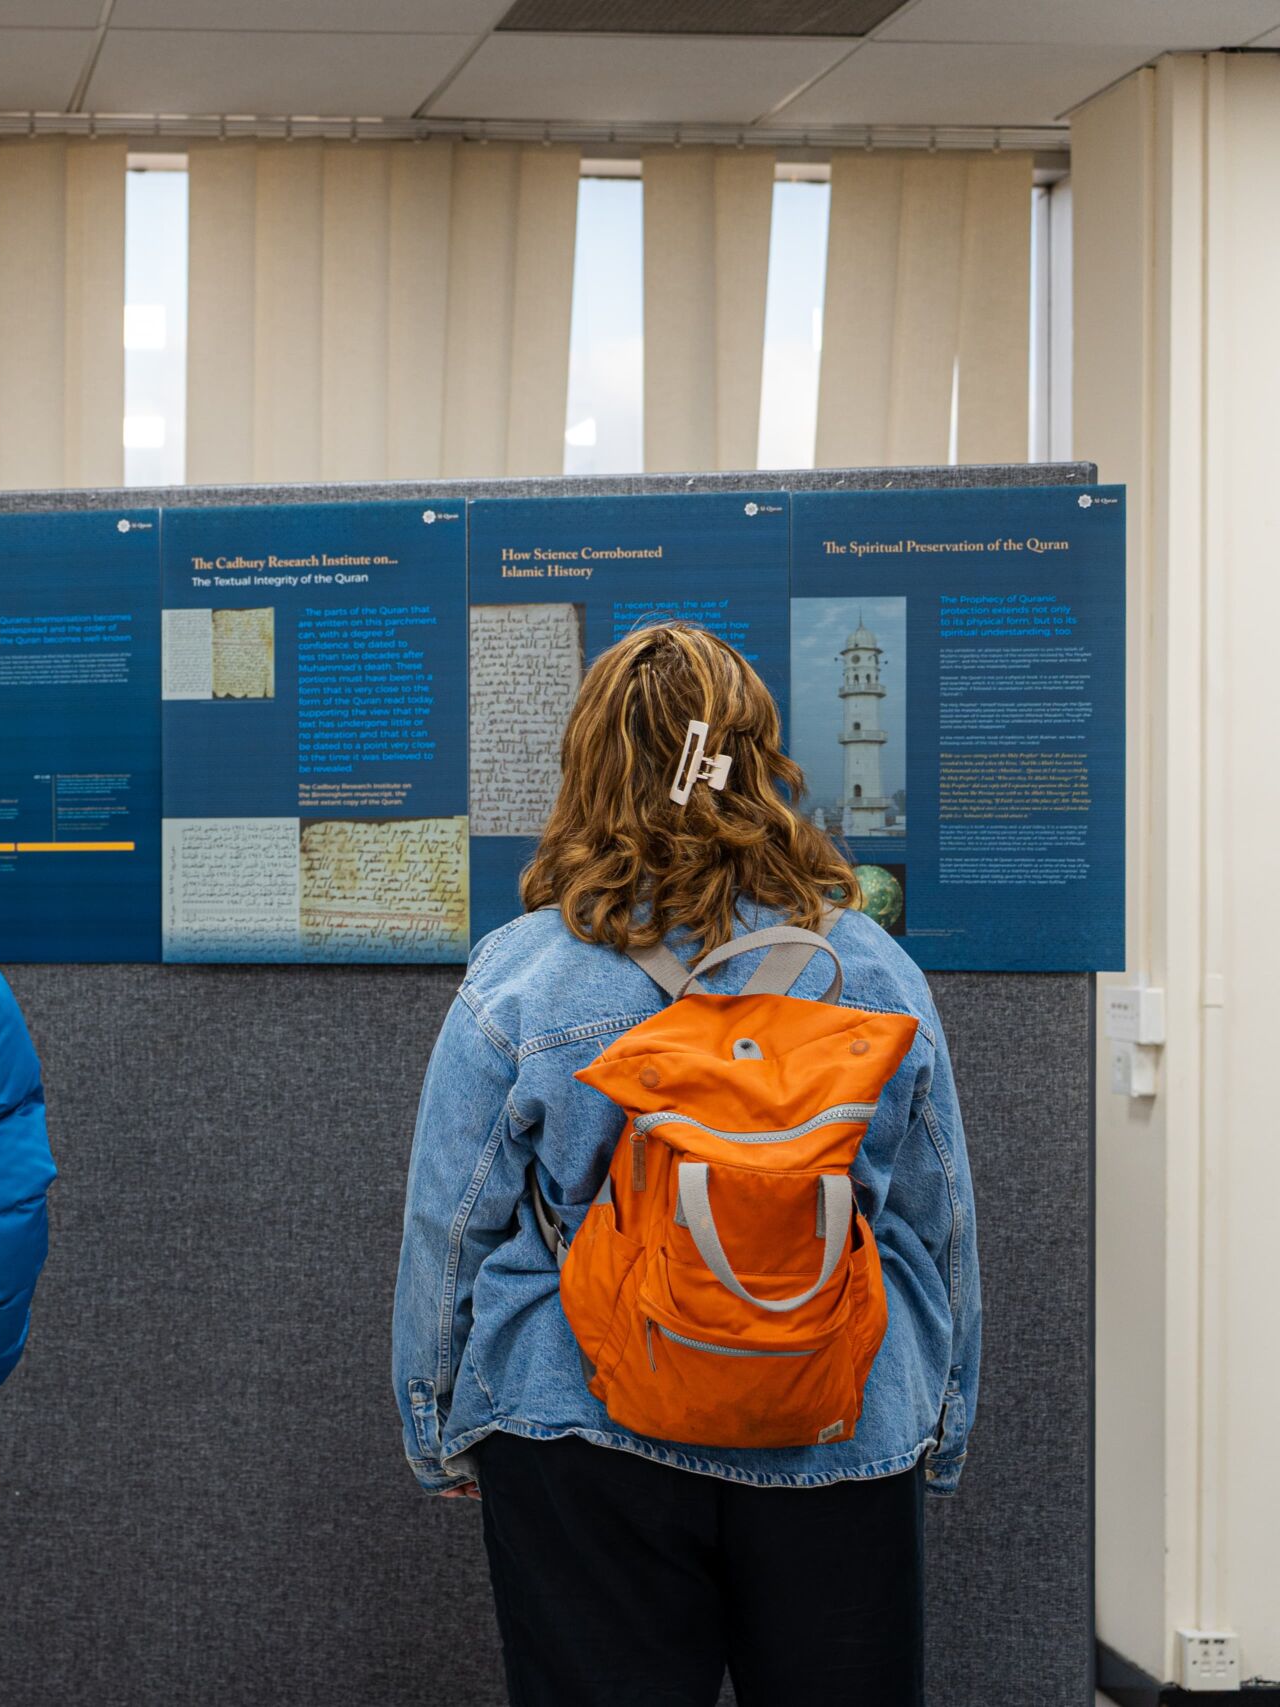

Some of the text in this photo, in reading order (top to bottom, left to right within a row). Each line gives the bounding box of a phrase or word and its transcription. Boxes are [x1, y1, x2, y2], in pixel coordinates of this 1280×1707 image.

[823, 537, 1069, 557] The Spiritual Preservation of the Quran
[501, 545, 663, 561] How Science Corroborated
[191, 554, 398, 571] The Cadbury Research Institute on...
[501, 564, 593, 580] Islamic History
[192, 573, 369, 588] The Textual Integrity of the Quran
[613, 601, 623, 609] In
[625, 601, 653, 609] recent
[683, 600, 699, 608] the
[719, 600, 729, 608] of
[940, 594, 1056, 605] The Prophecy of Quranic
[324, 607, 347, 618] parts
[349, 606, 359, 615] of
[361, 606, 377, 615] the
[380, 605, 408, 616] Quran
[410, 605, 430, 614] that
[705, 611, 721, 619] has
[940, 605, 1072, 616] protection extends not only
[0, 613, 132, 625] Quranic memorisation becomes
[298, 620, 313, 629] are
[315, 619, 348, 628] written
[350, 619, 363, 627] on
[365, 618, 382, 627] this
[940, 617, 951, 626] to
[953, 617, 963, 626] its
[966, 616, 1003, 627] physical
[1033, 616, 1050, 625] but
[1053, 616, 1063, 625] to
[1065, 616, 1077, 625] its
[0, 624, 117, 635] widespread and the order of
[729, 621, 750, 629] how
[320, 629, 340, 639] with
[350, 629, 383, 640] degree
[385, 629, 395, 638] of
[730, 632, 747, 640] the
[940, 628, 977, 638] spiritual
[0, 637, 13, 645] the
[15, 636, 41, 646] Quran
[43, 635, 81, 645] becomes
[353, 641, 366, 650] be
[368, 640, 395, 649] dated
[398, 640, 408, 649] to
[298, 651, 424, 662] less than two decades after
[299, 663, 362, 673] Muhammad's
[396, 662, 422, 671] These
[299, 674, 337, 685] portions
[339, 674, 363, 683] must
[365, 674, 387, 683] have
[389, 673, 413, 682] been
[415, 673, 425, 681] in
[299, 684, 430, 696] form that is very close to the
[299, 697, 321, 706] form
[322, 697, 333, 706] of
[335, 697, 350, 706] the
[352, 697, 381, 707] Quran
[383, 696, 405, 705] read
[299, 764, 311, 773] be
[298, 783, 311, 791] The
[312, 783, 340, 792] Cadbury
[341, 782, 372, 791] Research
[373, 782, 401, 790] Institute
[298, 791, 310, 799] the
[311, 791, 353, 800] Birmingham
[395, 790, 407, 798] the
[298, 799, 319, 807] oldest
[320, 799, 342, 807] extant
[343, 799, 359, 808] copy
[360, 798, 368, 806] of
[369, 798, 380, 806] the
